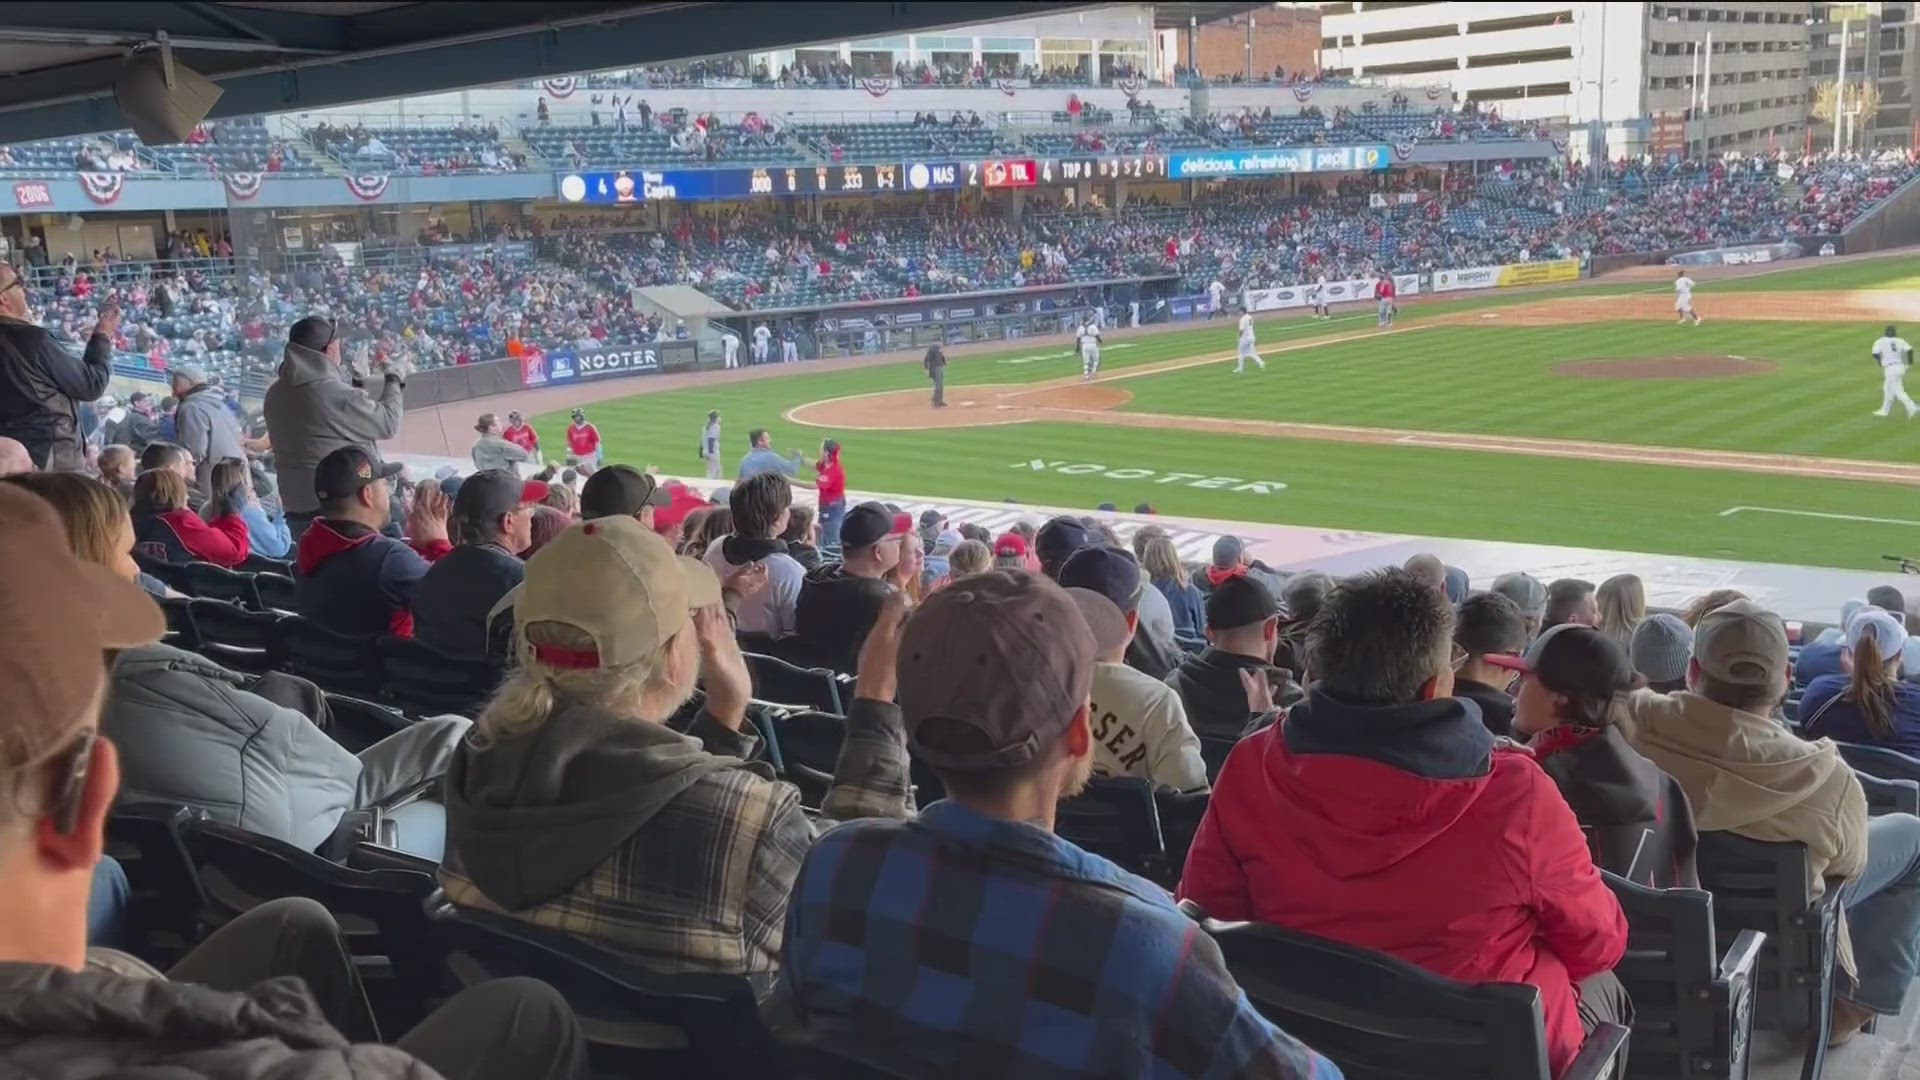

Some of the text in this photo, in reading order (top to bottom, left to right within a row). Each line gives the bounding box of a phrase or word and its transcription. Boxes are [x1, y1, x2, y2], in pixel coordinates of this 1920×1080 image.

[932, 165, 955, 185] NAS
[968, 163, 977, 186] 2
[1010, 163, 1029, 181] TOL
[1042, 160, 1052, 183] 4
[1062, 161, 1080, 179] TOP
[1110, 159, 1119, 178] 3
[1123, 158, 1142, 177] S 2
[1158, 158, 1165, 176] 1
[579, 350, 657, 371] NOOTER
[1008, 459, 1288, 494] NOOTER
